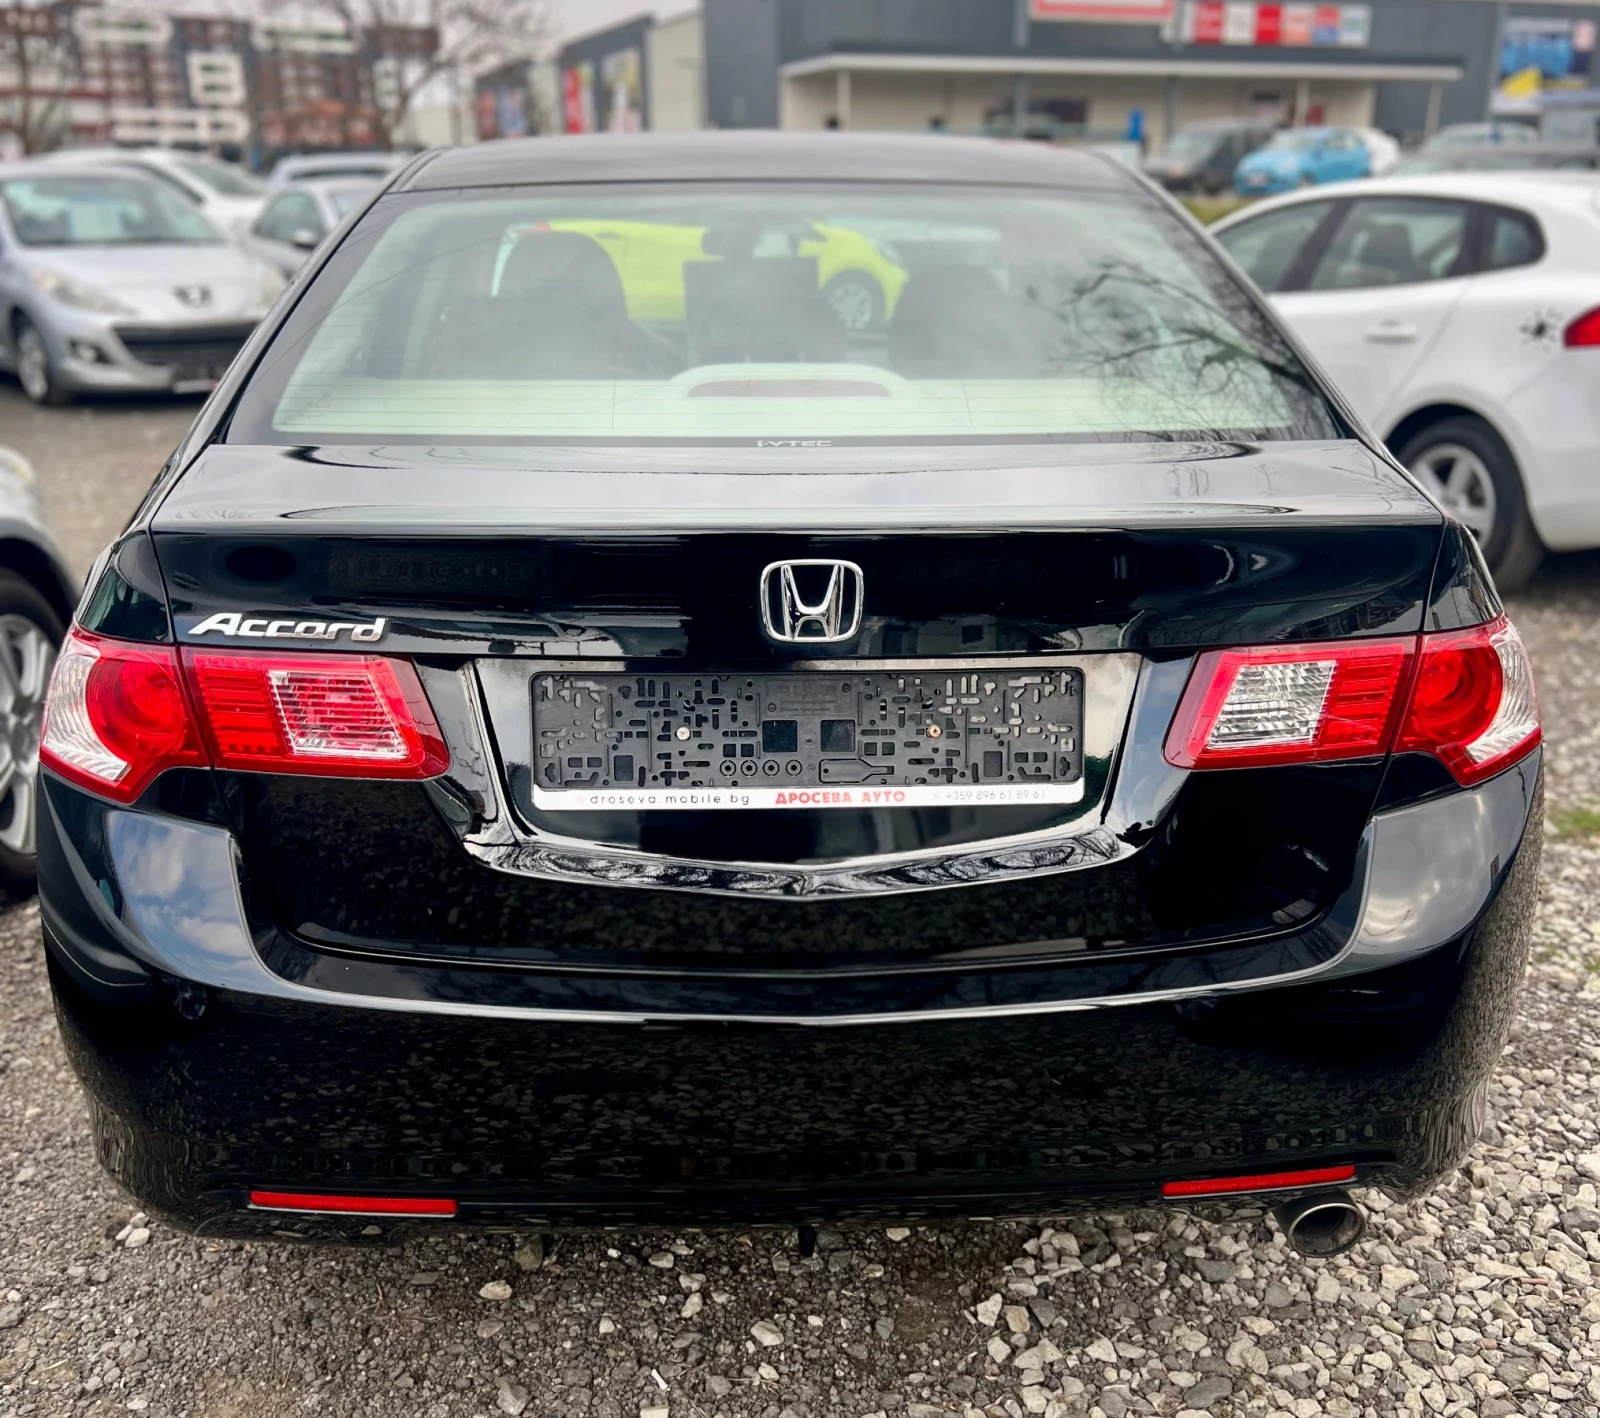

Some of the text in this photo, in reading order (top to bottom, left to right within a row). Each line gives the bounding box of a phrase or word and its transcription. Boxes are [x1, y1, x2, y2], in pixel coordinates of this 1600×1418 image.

[188, 612, 388, 642] Accord
[590, 794, 750, 805] droseva.mobile.bg
[775, 790, 906, 805] ДРОСЕВА АУТО
[945, 788, 1045, 801] +359 896 61 89 61
